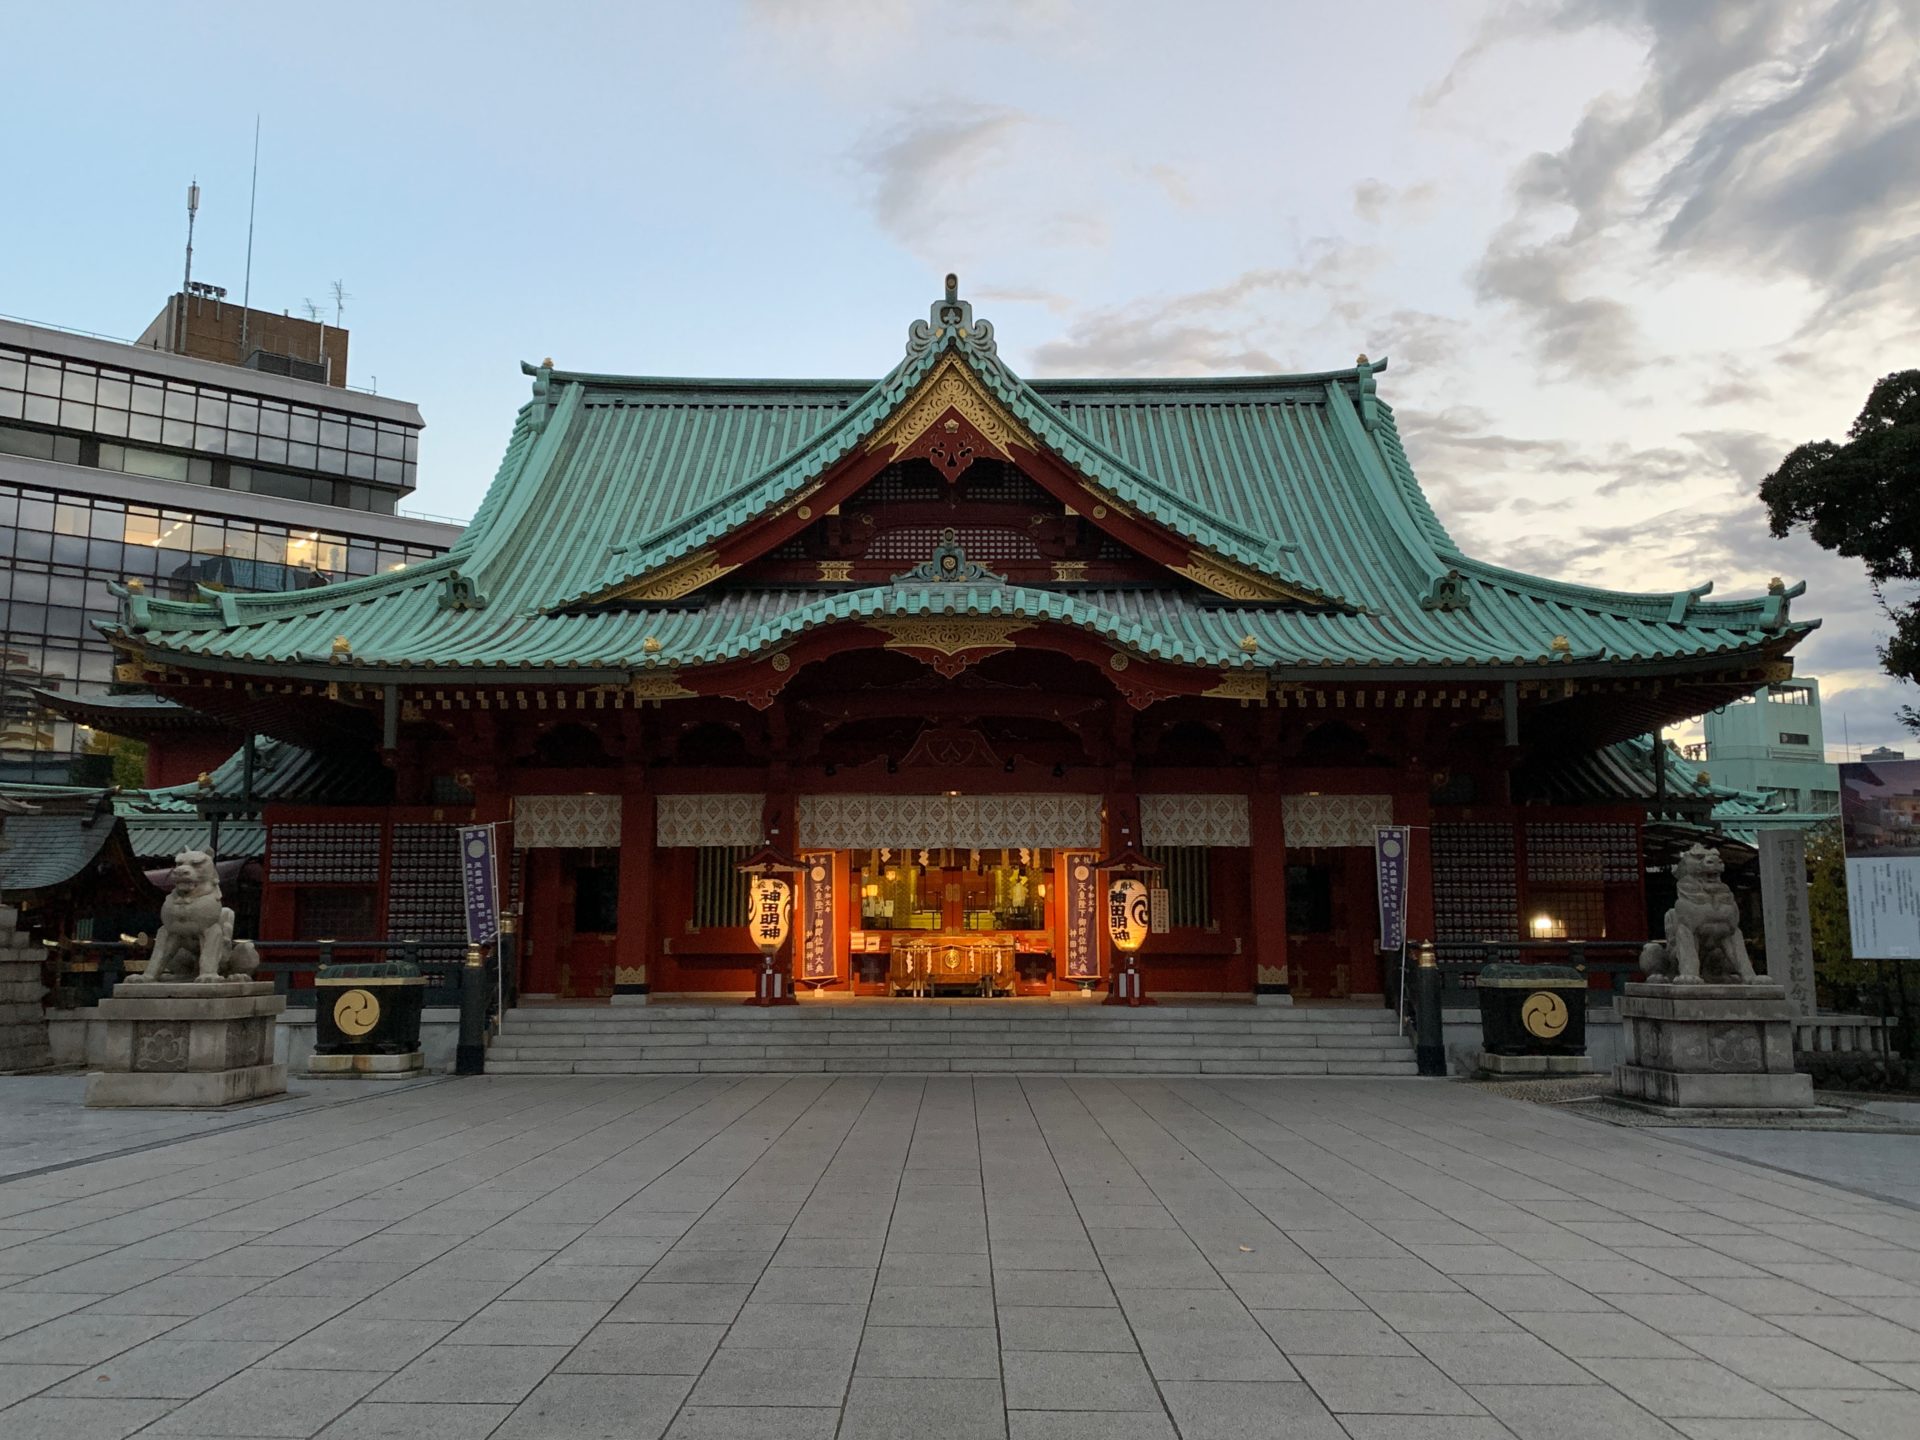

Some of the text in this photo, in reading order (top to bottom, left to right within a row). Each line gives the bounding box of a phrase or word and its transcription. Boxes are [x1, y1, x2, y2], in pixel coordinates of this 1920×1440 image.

[760, 889, 781, 939] 神田明神
[1110, 890, 1130, 942] 神田明神
